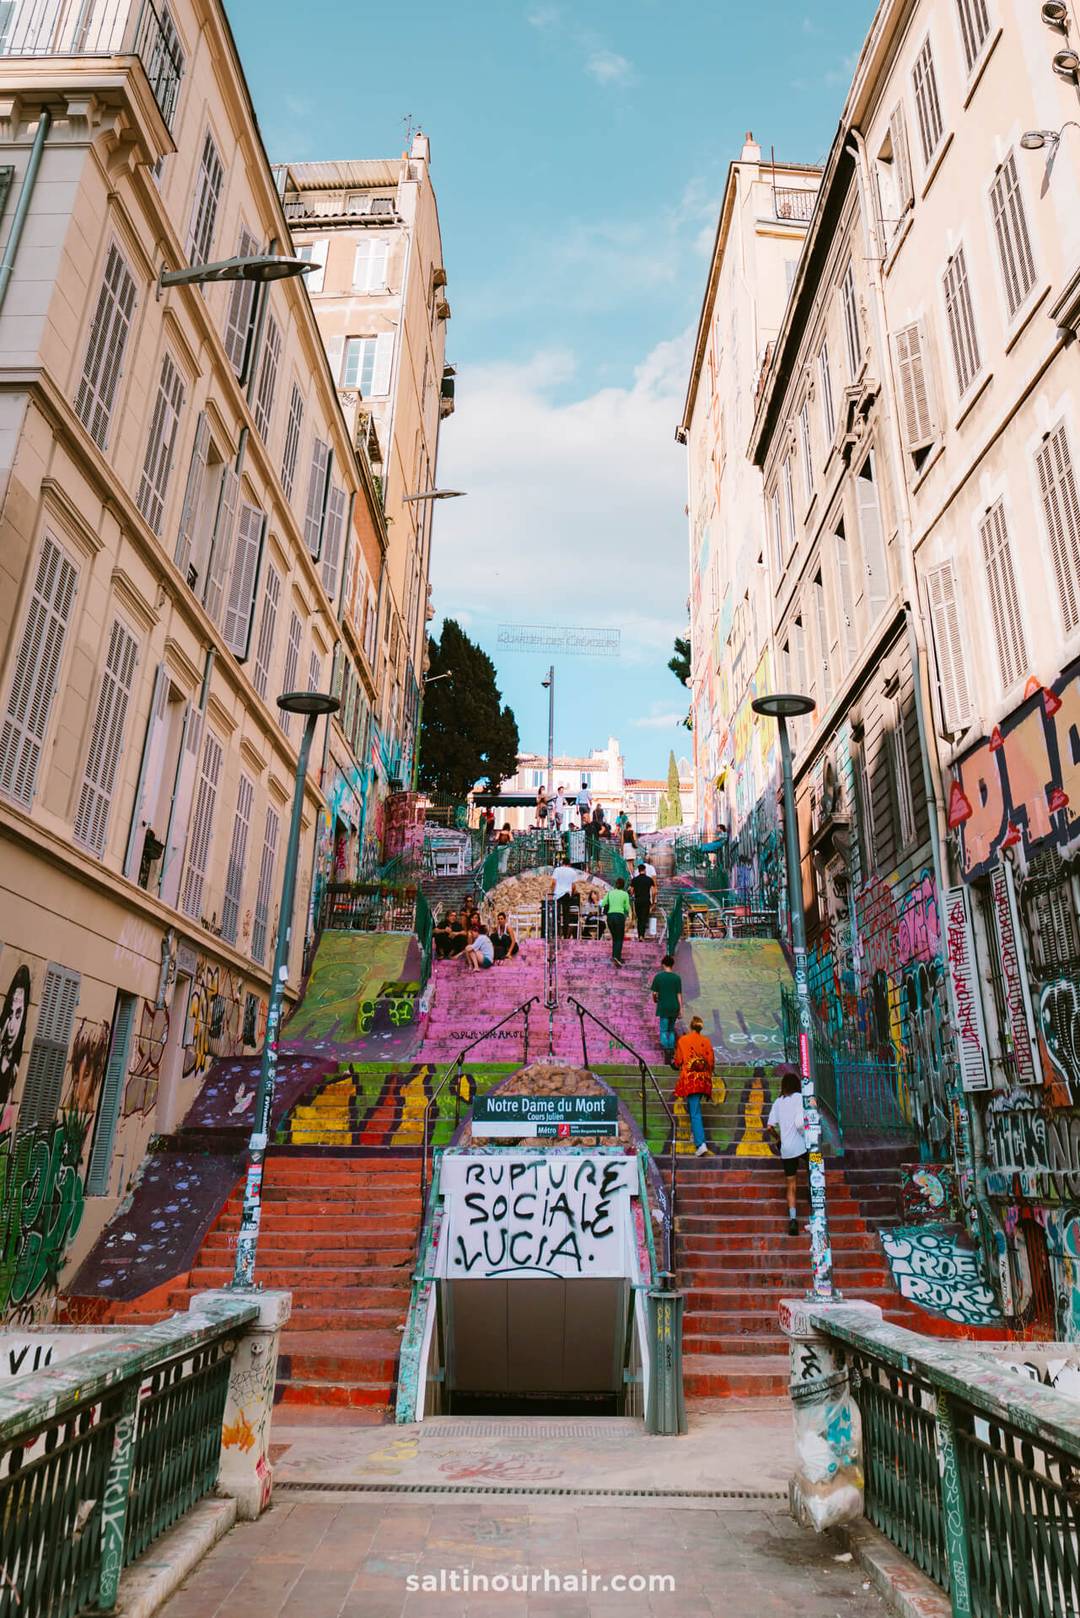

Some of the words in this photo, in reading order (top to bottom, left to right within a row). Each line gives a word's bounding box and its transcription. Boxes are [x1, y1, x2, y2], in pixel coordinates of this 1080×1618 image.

[487, 1098, 519, 1112] Notre
[522, 1098, 555, 1112] Dame
[557, 1098, 572, 1112] du
[575, 1098, 606, 1112] Mont
[527, 1112, 546, 1121] Cours
[546, 1112, 564, 1122] Julien
[538, 1126, 557, 1134] Métro
[466, 1159, 628, 1199] RUPTURE
